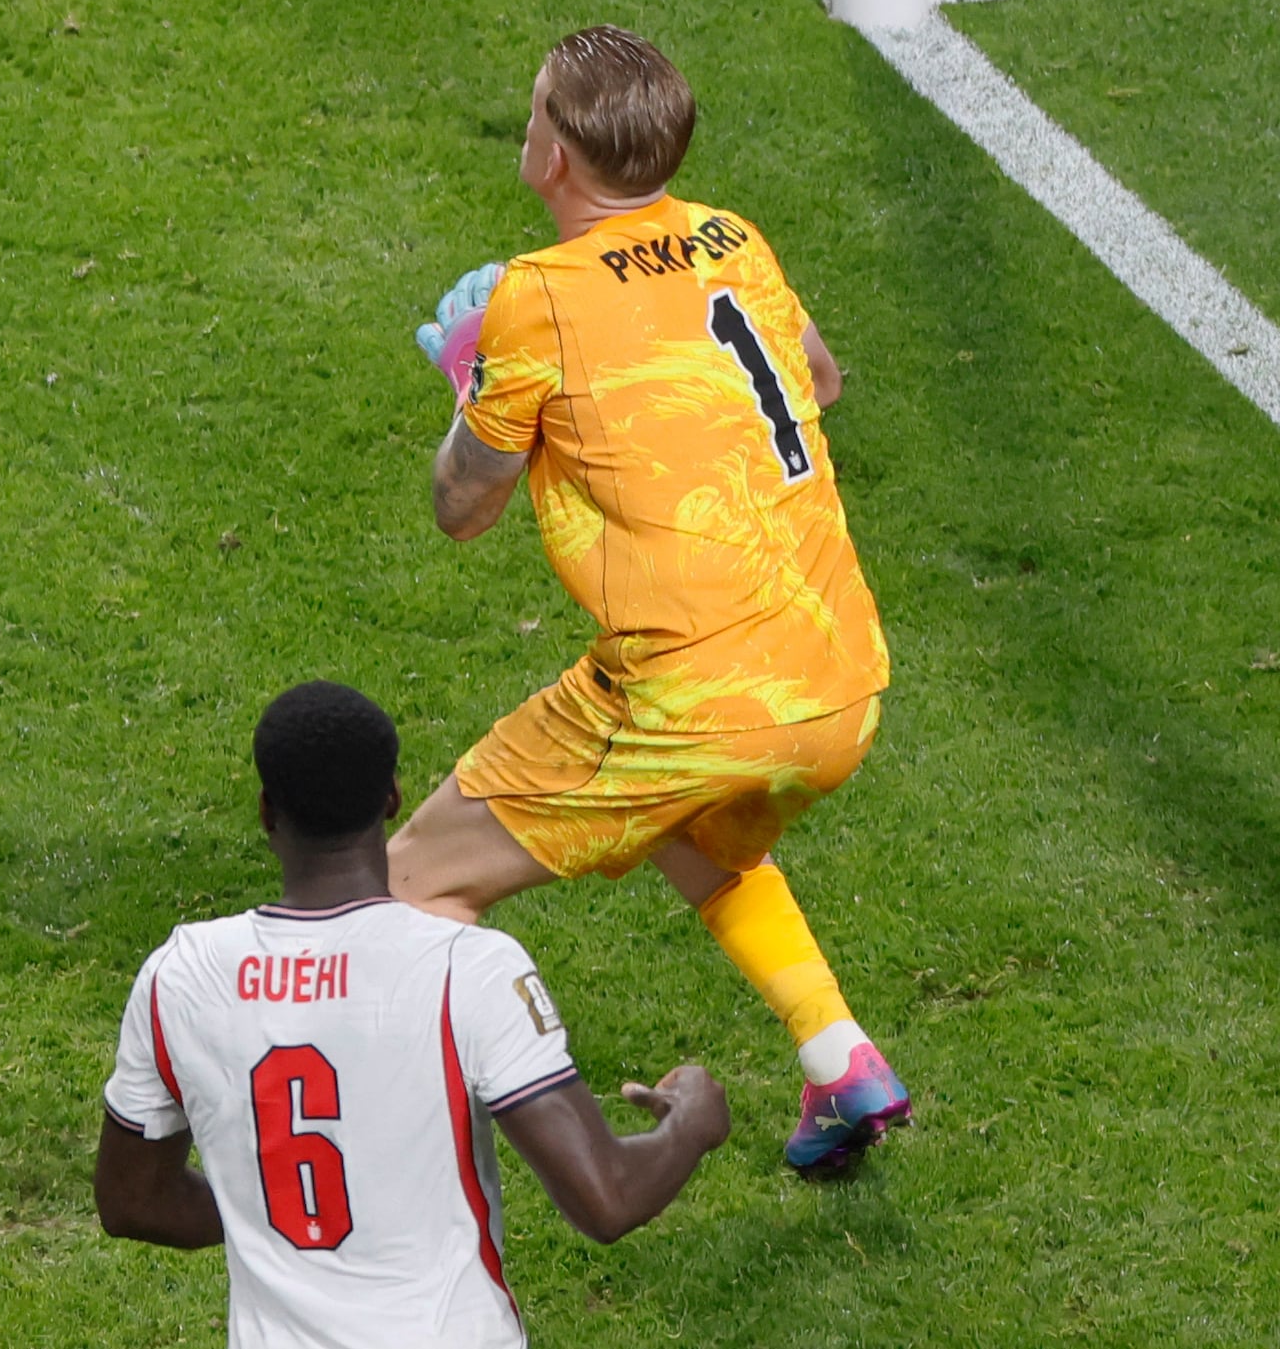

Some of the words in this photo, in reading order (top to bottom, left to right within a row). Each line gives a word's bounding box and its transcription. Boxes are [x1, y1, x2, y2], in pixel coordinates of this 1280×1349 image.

[706, 286, 815, 486] 1
[237, 948, 348, 1003] GUÉHI
[250, 1043, 353, 1251] 6
